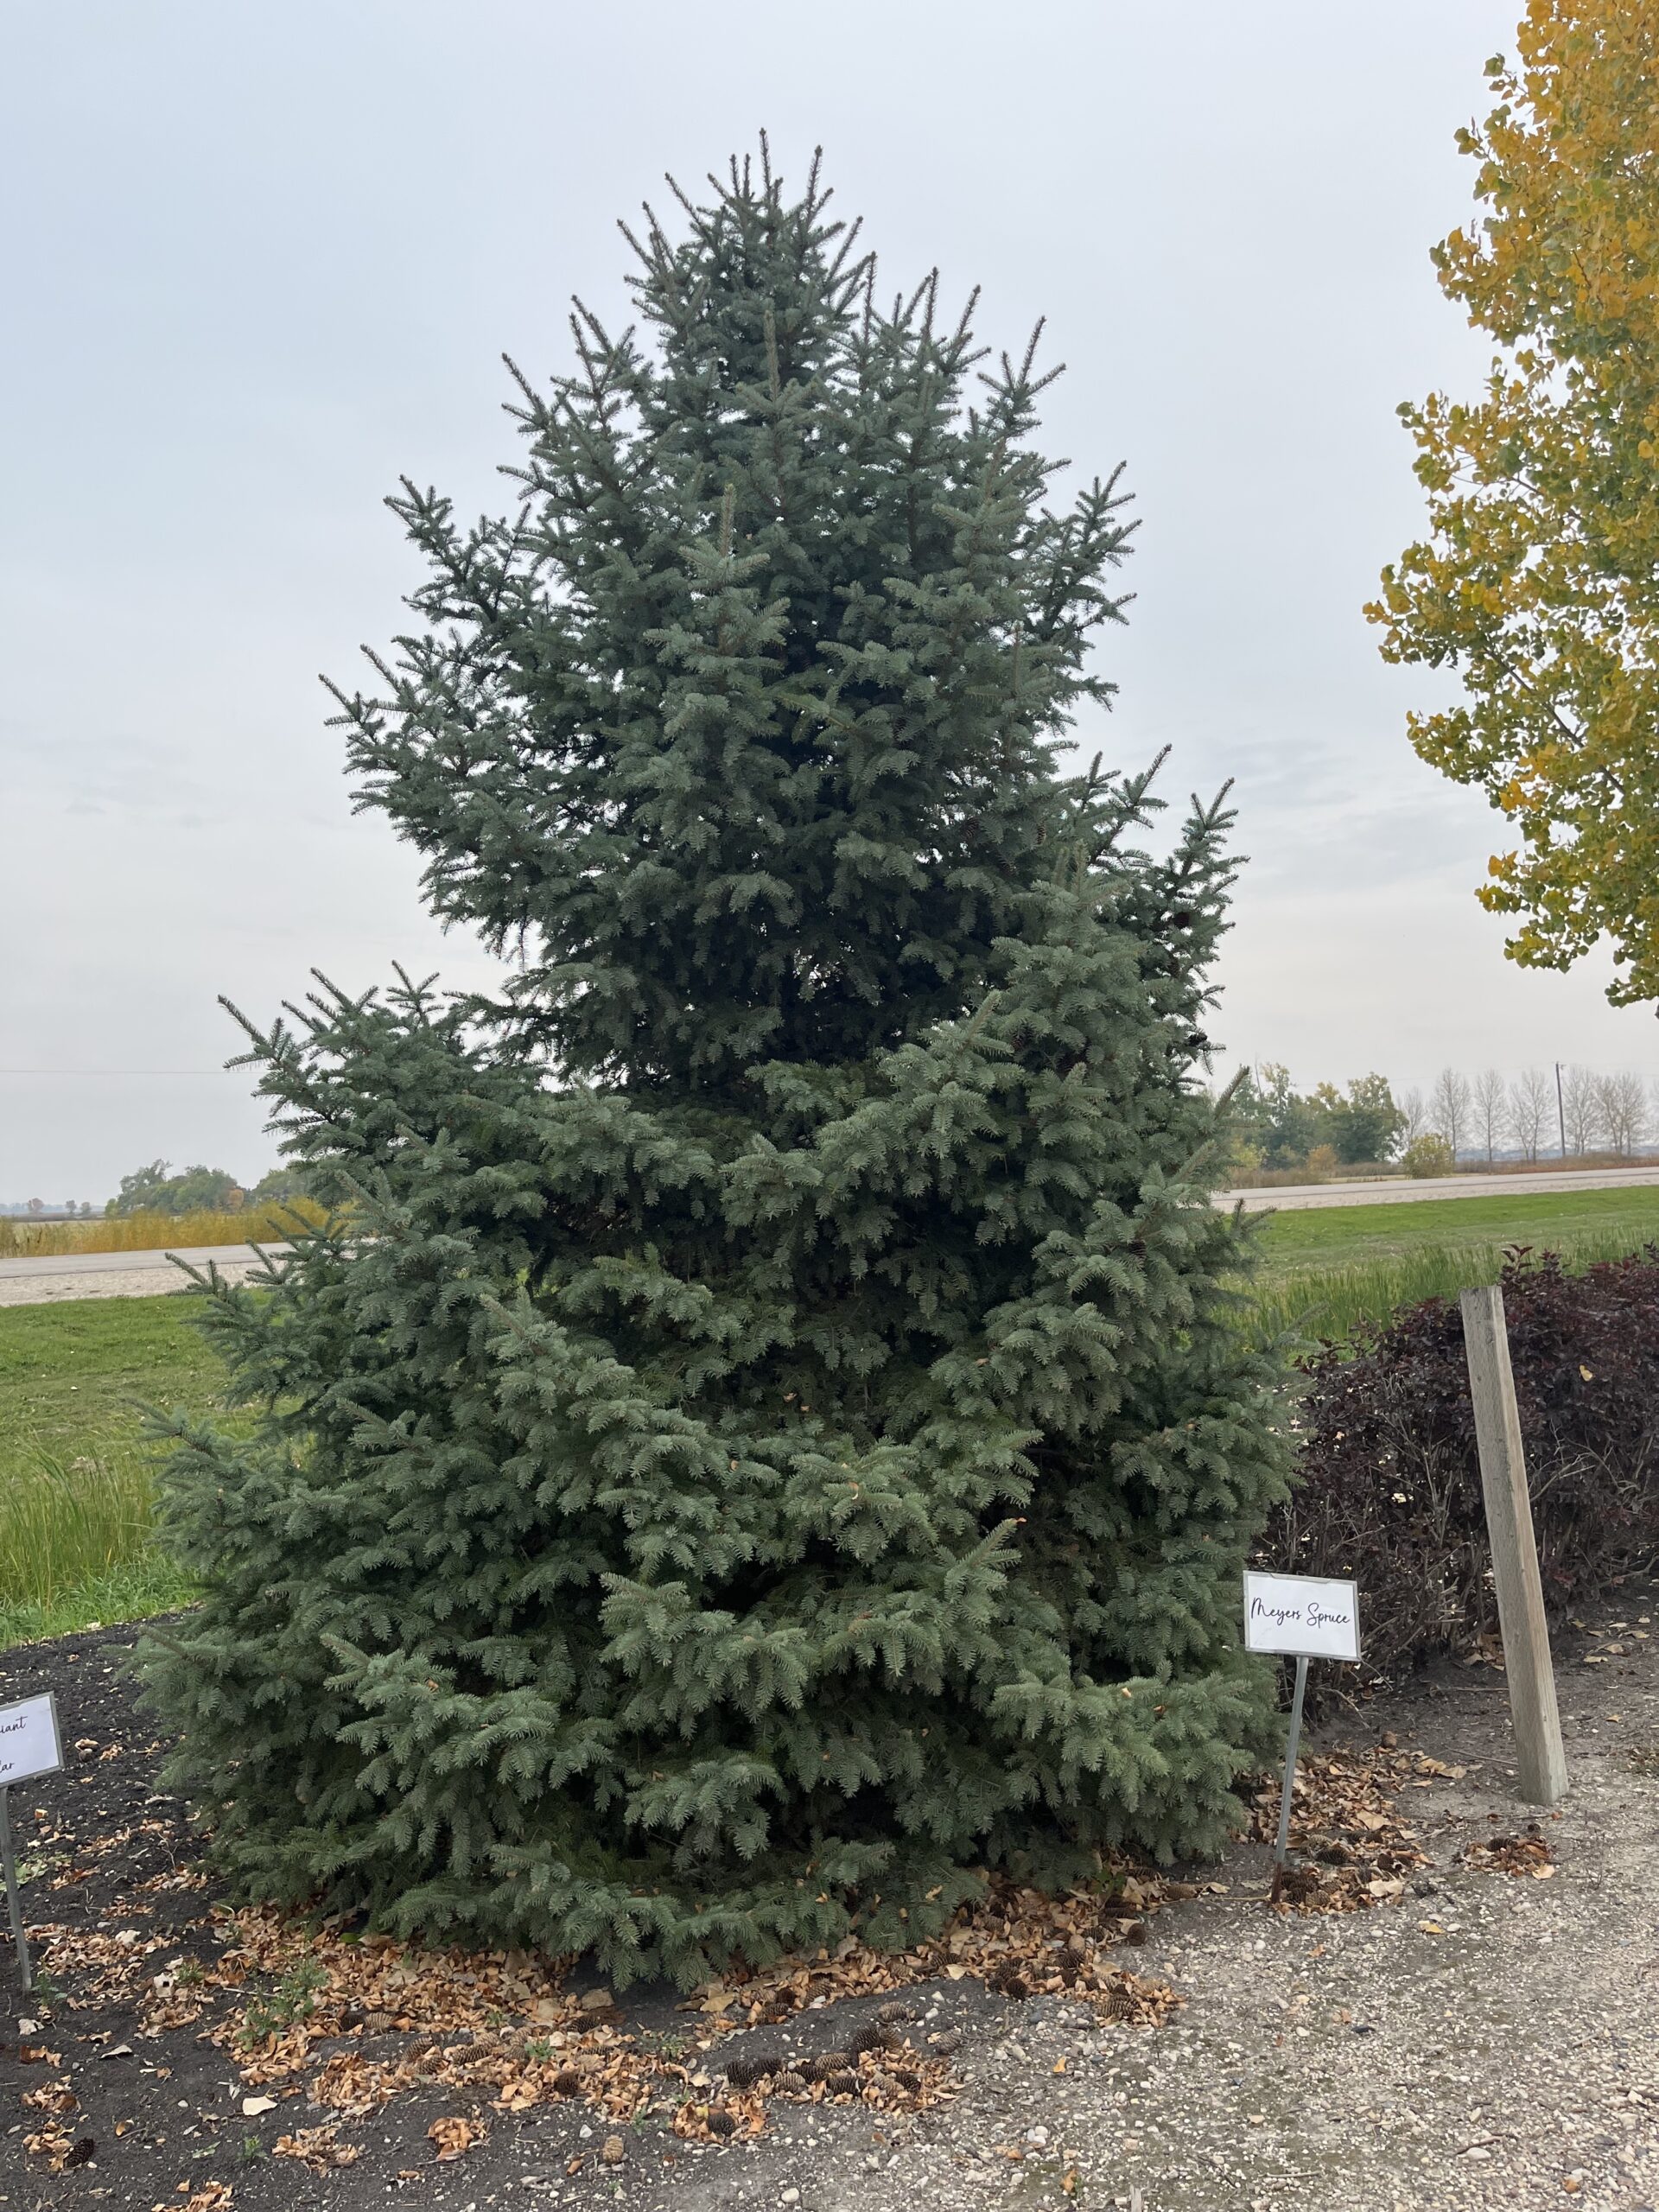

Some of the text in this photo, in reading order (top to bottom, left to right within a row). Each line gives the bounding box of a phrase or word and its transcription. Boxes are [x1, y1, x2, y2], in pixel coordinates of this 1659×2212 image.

[1251, 1597, 1351, 1629] Meyers Spruce
[0, 1716, 28, 1733] iant
[0, 1760, 15, 1773] ar
